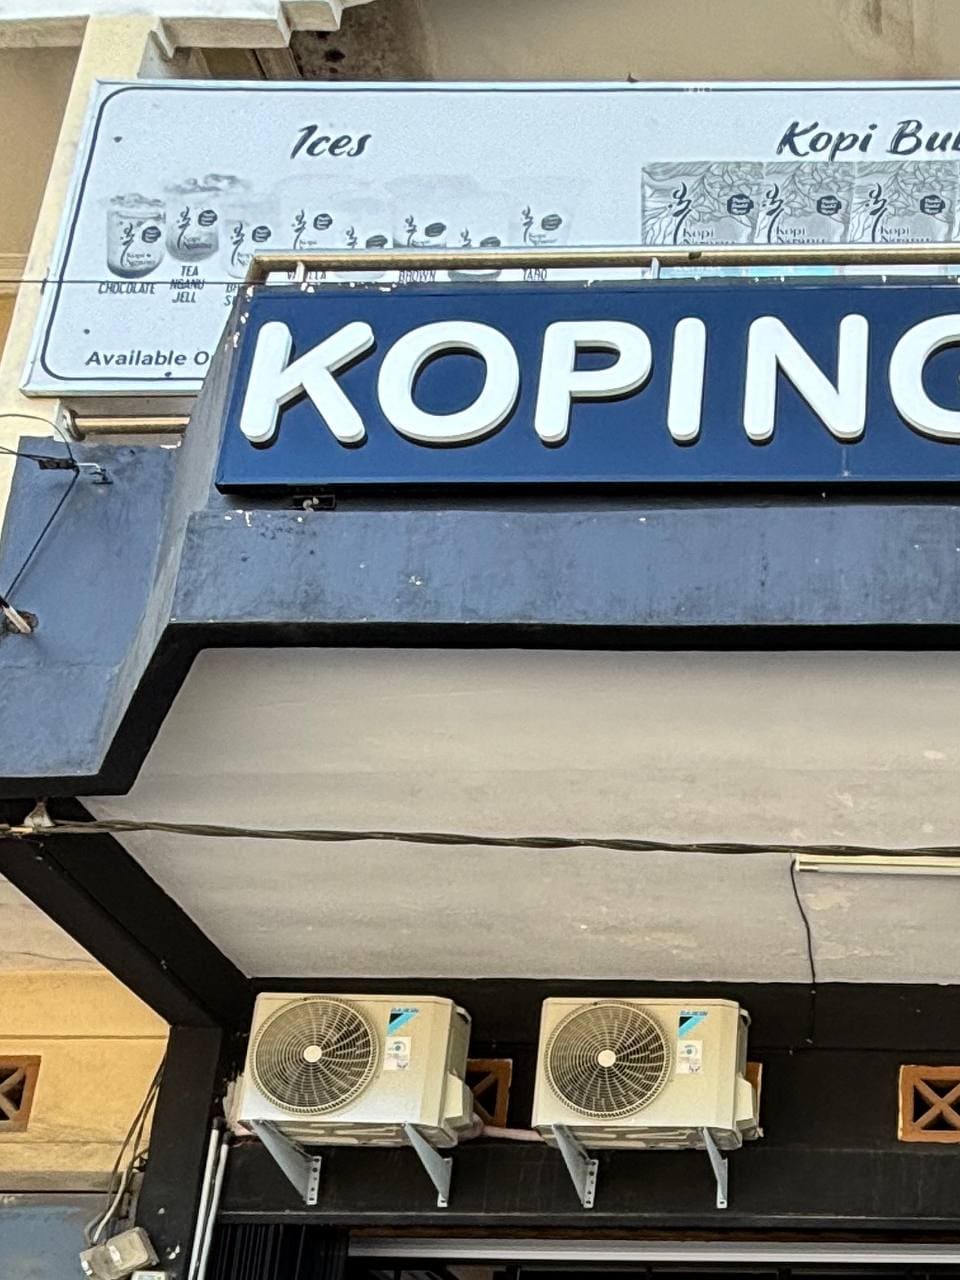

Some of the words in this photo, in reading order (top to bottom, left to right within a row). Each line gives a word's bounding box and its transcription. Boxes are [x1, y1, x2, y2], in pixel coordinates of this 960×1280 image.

[290, 124, 373, 160] Ices
[776, 120, 878, 162] Kopi
[180, 266, 199, 277] TEA
[98, 282, 156, 295] CHOCOLATE
[172, 291, 197, 303] JELL
[85, 351, 187, 366] Available
[194, 351, 213, 366] O
